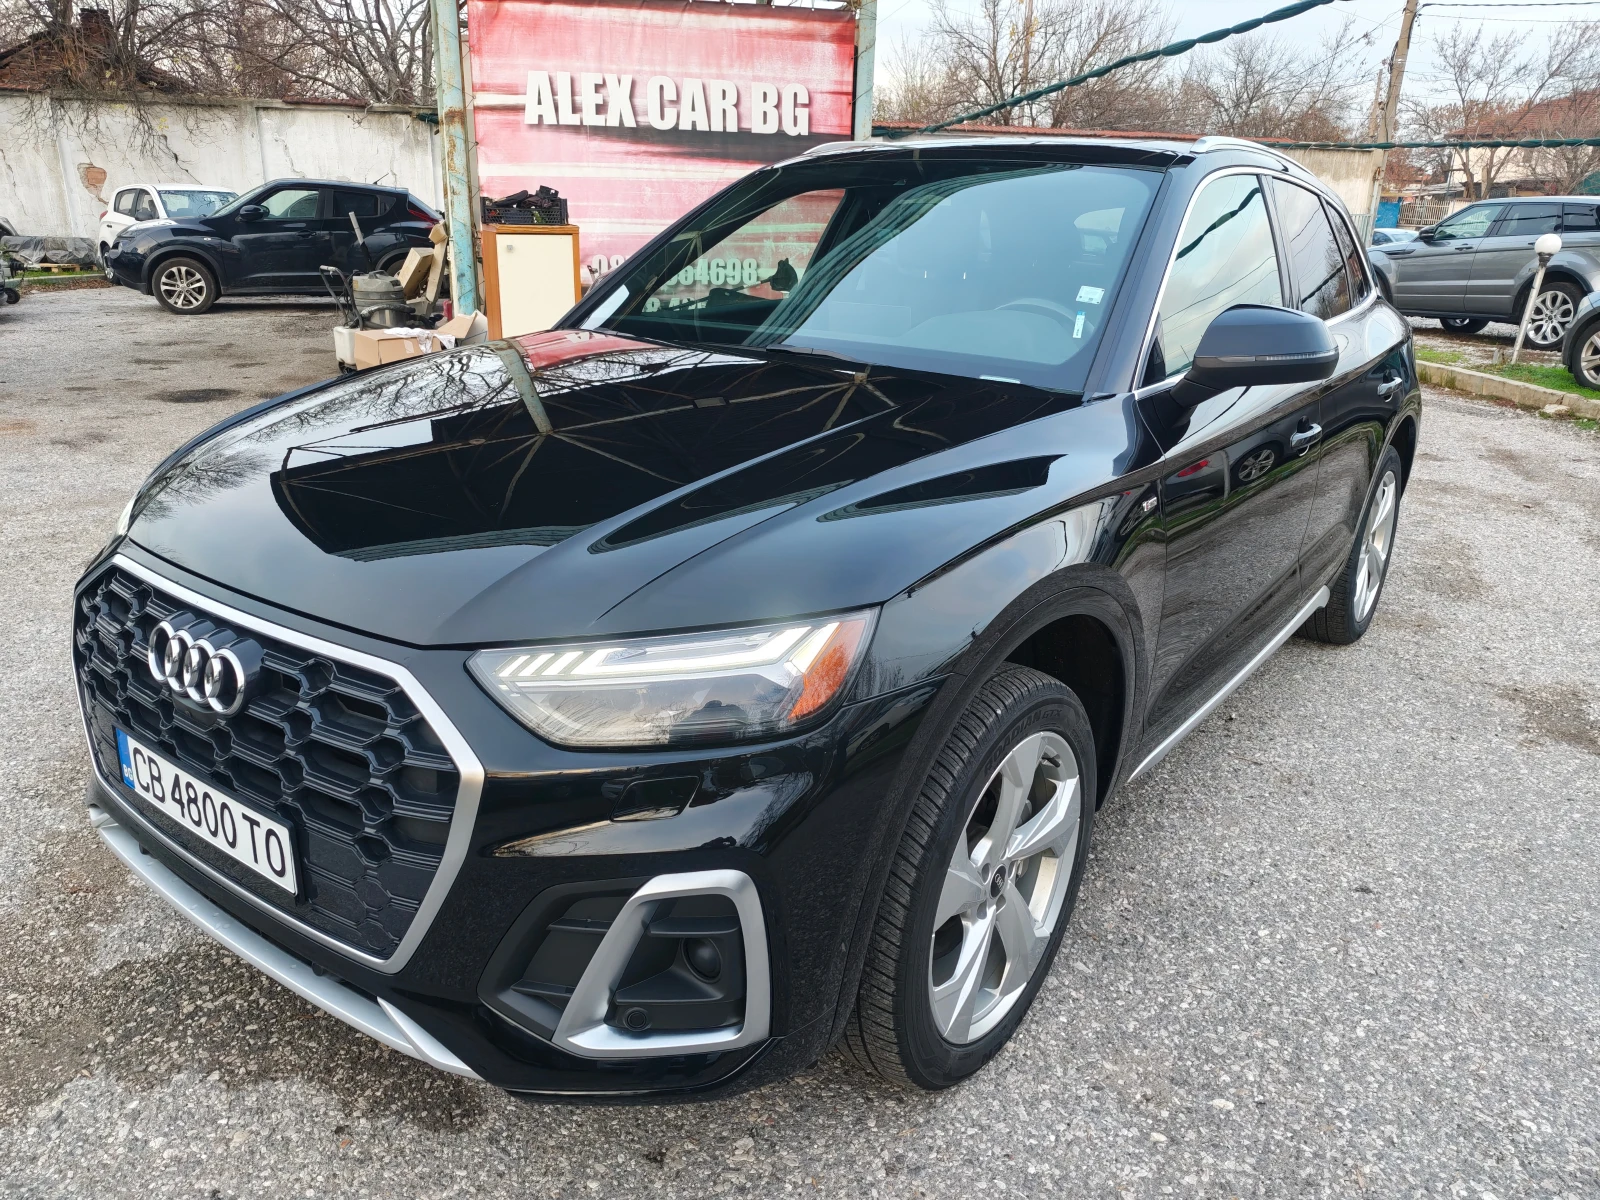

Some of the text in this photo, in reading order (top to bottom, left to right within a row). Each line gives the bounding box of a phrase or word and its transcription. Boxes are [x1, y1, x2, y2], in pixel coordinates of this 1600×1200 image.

[524, 70, 810, 136] ALEX CAR BG
[122, 764, 134, 781] BG
[132, 746, 287, 878] CB 4800 TO
